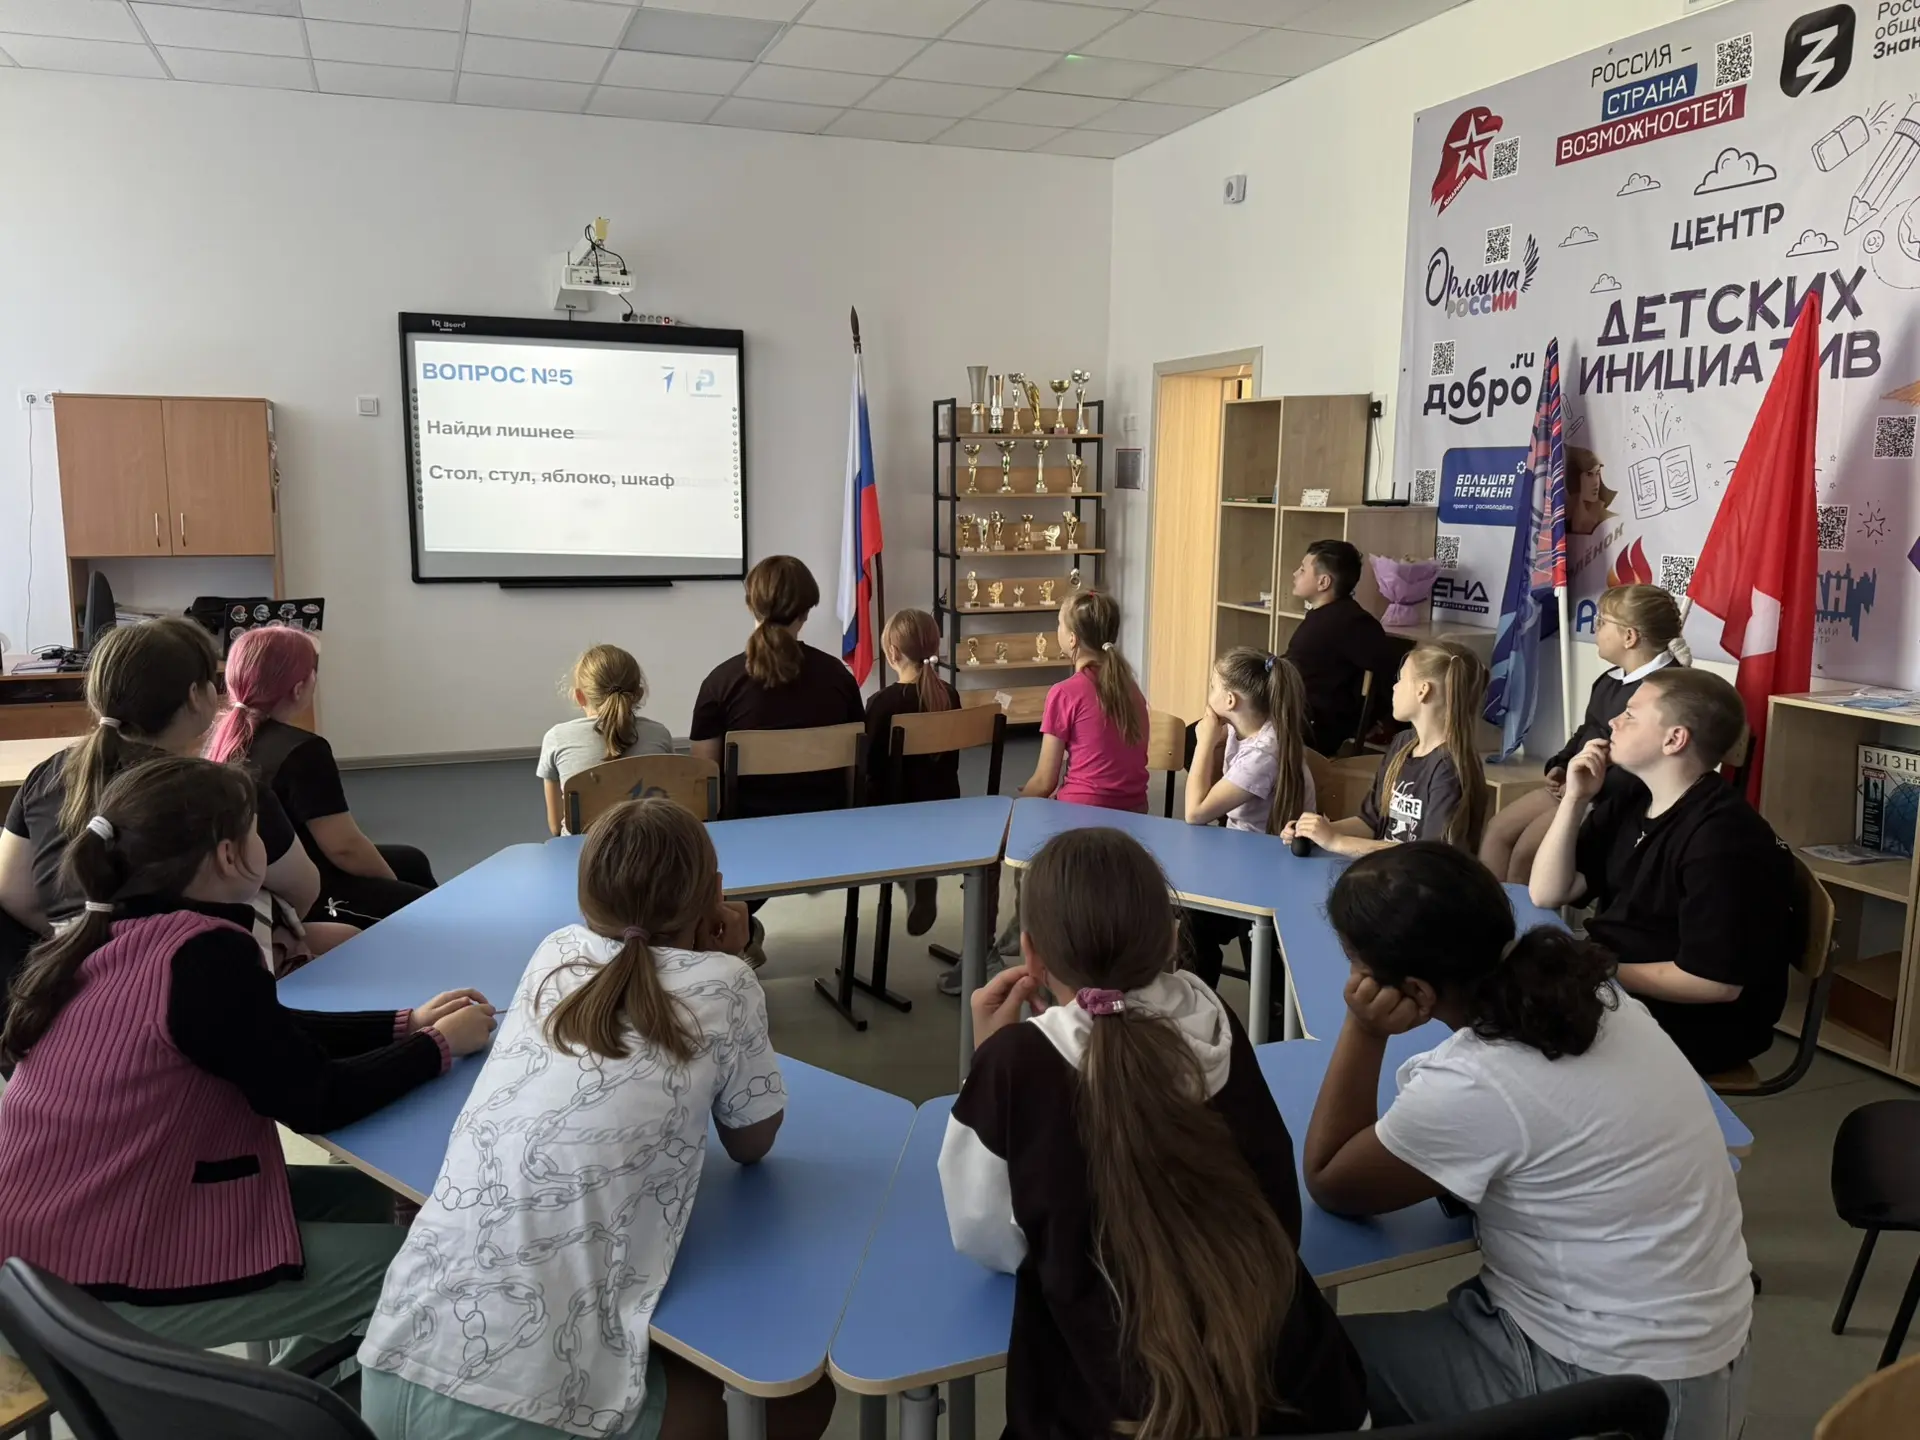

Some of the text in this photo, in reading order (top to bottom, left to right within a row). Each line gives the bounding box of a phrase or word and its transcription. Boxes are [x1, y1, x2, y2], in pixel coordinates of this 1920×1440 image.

[1875, 17, 1920, 40] общ
[1591, 44, 1672, 88] РОССИЯ
[1606, 76, 1688, 116] СТРАНА
[1561, 91, 1735, 160] ВОЗМОЖНОСТЕЙ
[1670, 203, 1785, 251] ЦЕНТР
[1425, 246, 1520, 308] Орлята
[1446, 290, 1518, 319] РОССИИ
[1597, 265, 1867, 346] ДЕТСКИХ
[1509, 349, 1535, 370] .ru
[422, 362, 573, 387] ВОПРОС №5
[1423, 366, 1533, 416] добро
[427, 420, 575, 440] Найди лишнее
[428, 464, 676, 490] Стол, стул, яблоко, шкаф
[1456, 474, 1516, 487] БОЛЬШАЯ
[1453, 486, 1514, 499] ПЕРЕМЕНА
[1568, 522, 1624, 578] ЛЁНОК
[1431, 577, 1490, 602] ЕНА
[1863, 750, 1917, 772] БИЗН
